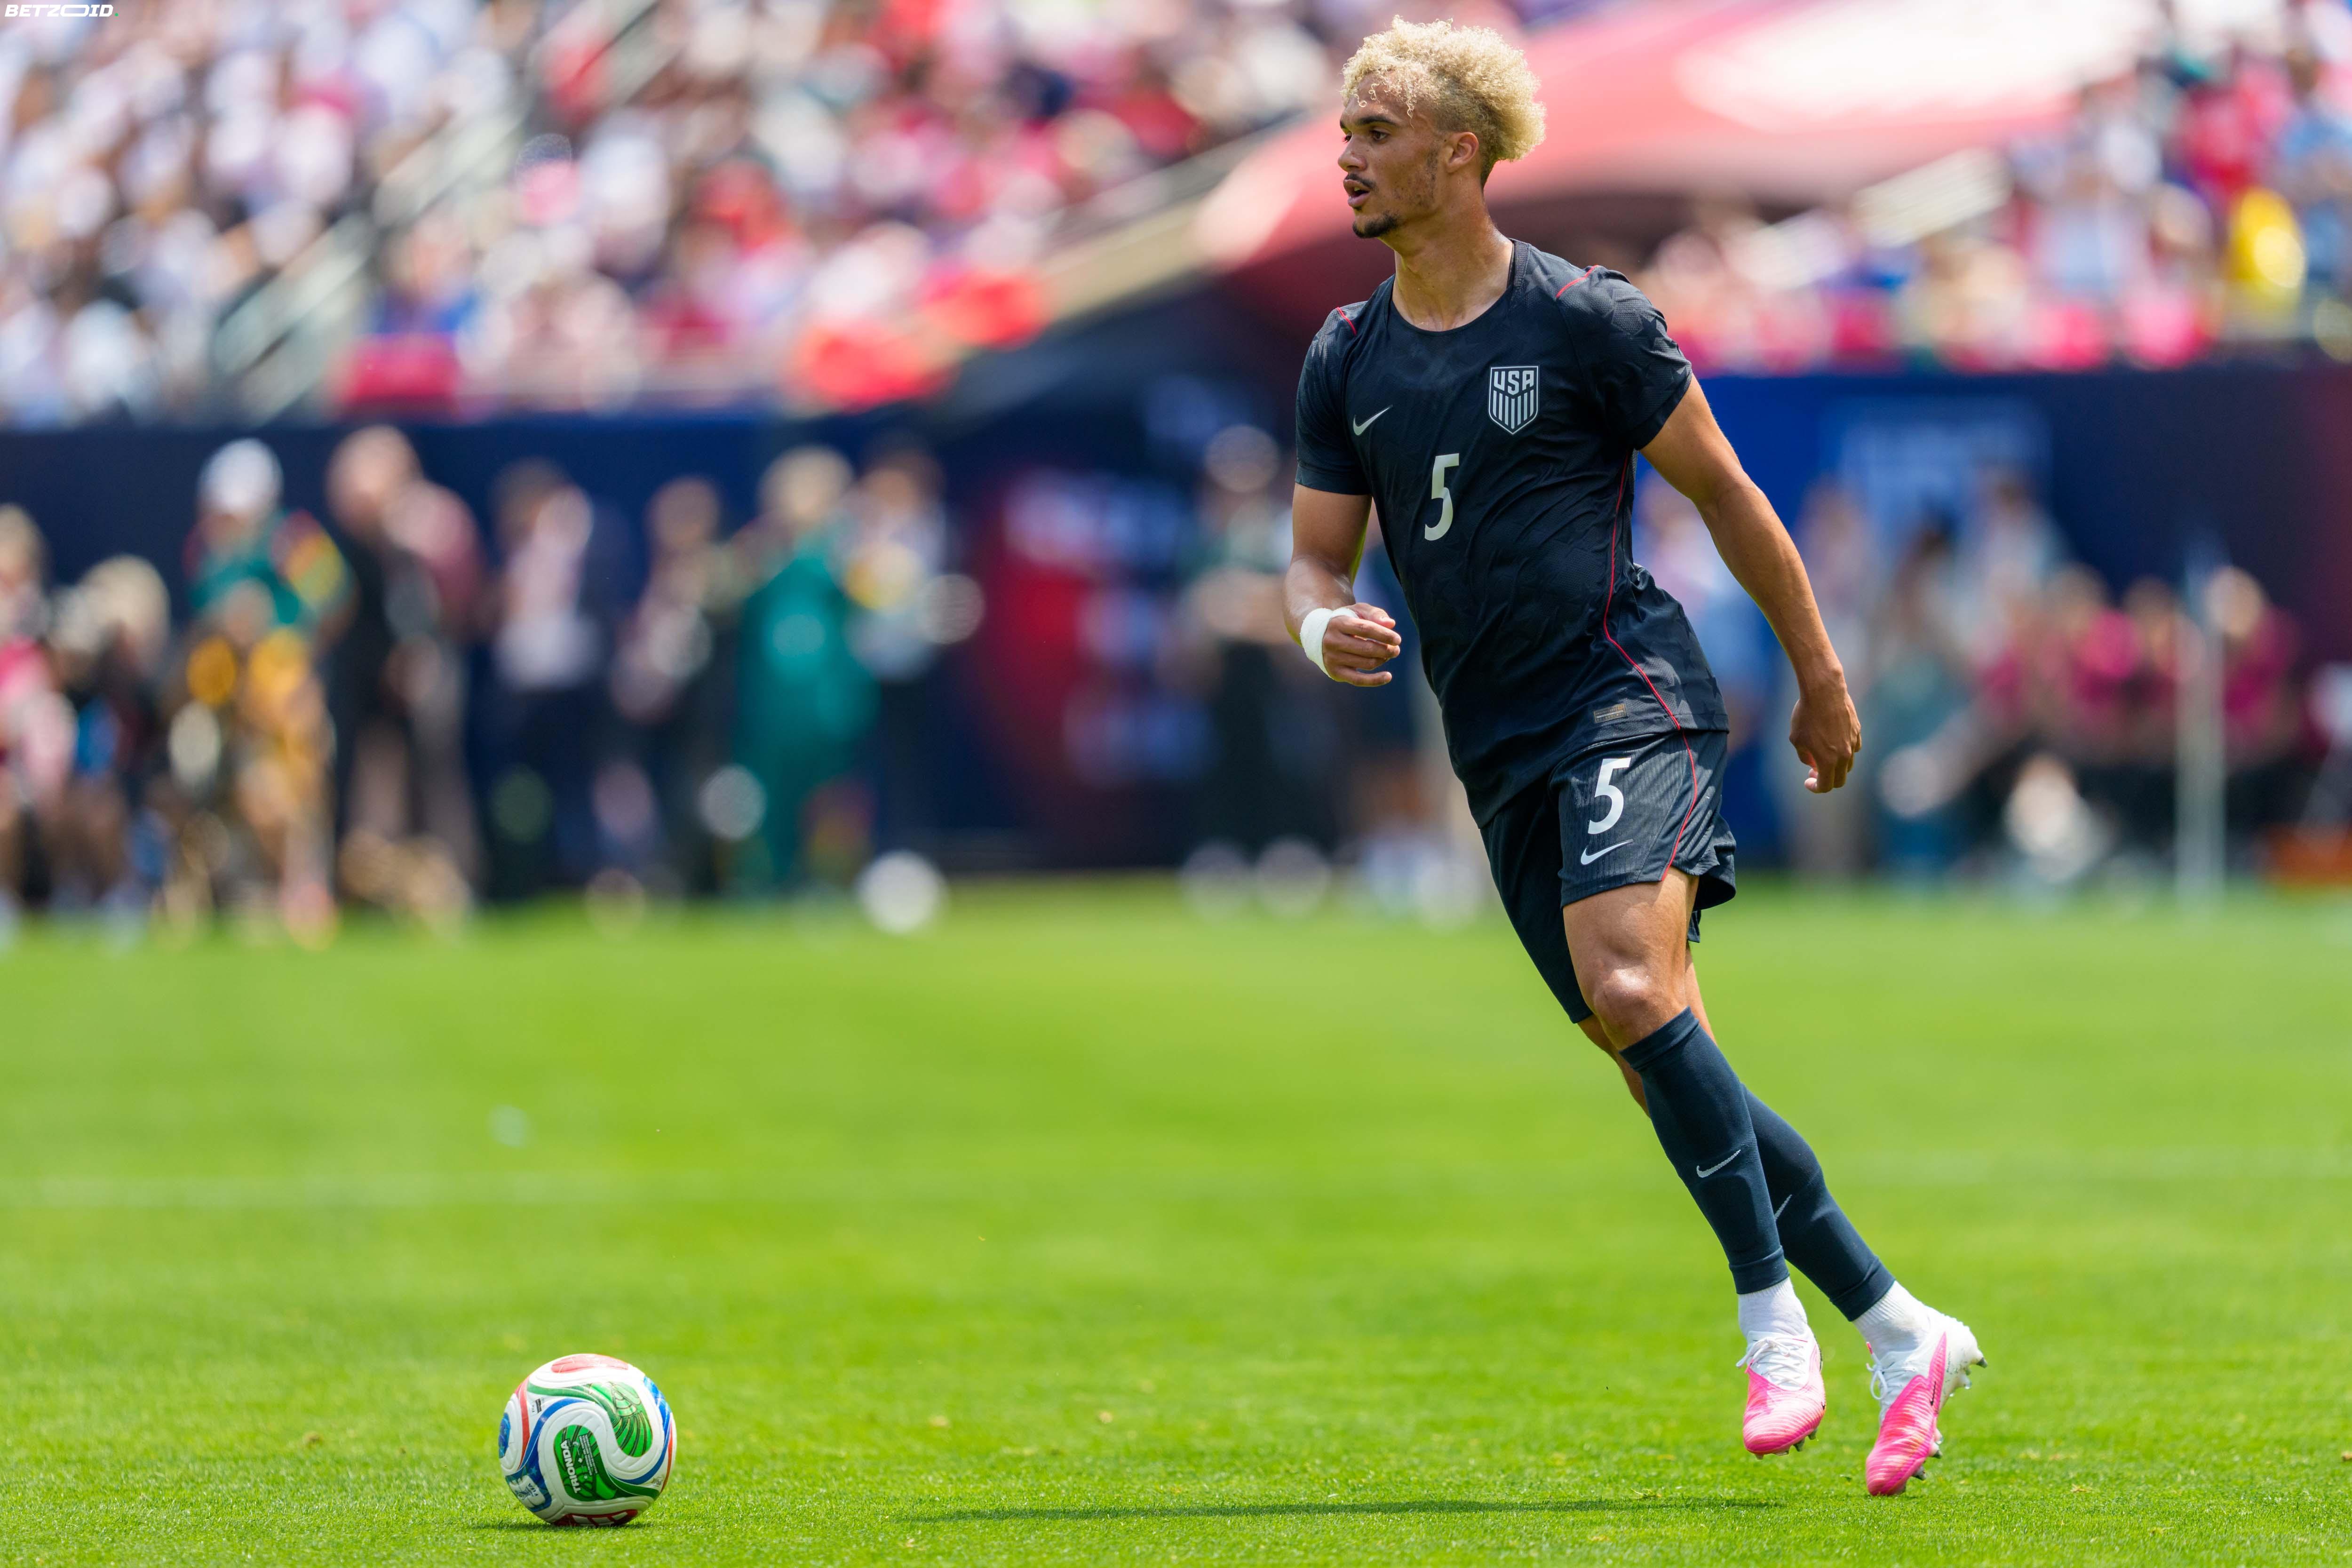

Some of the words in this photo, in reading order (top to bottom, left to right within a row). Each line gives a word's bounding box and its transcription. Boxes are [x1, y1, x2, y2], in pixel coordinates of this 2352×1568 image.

[1494, 370, 1534, 395] USA
[1424, 453, 1460, 541] 5
[1588, 757, 1632, 835] 5
[561, 1440, 581, 1493] TRIONDA
